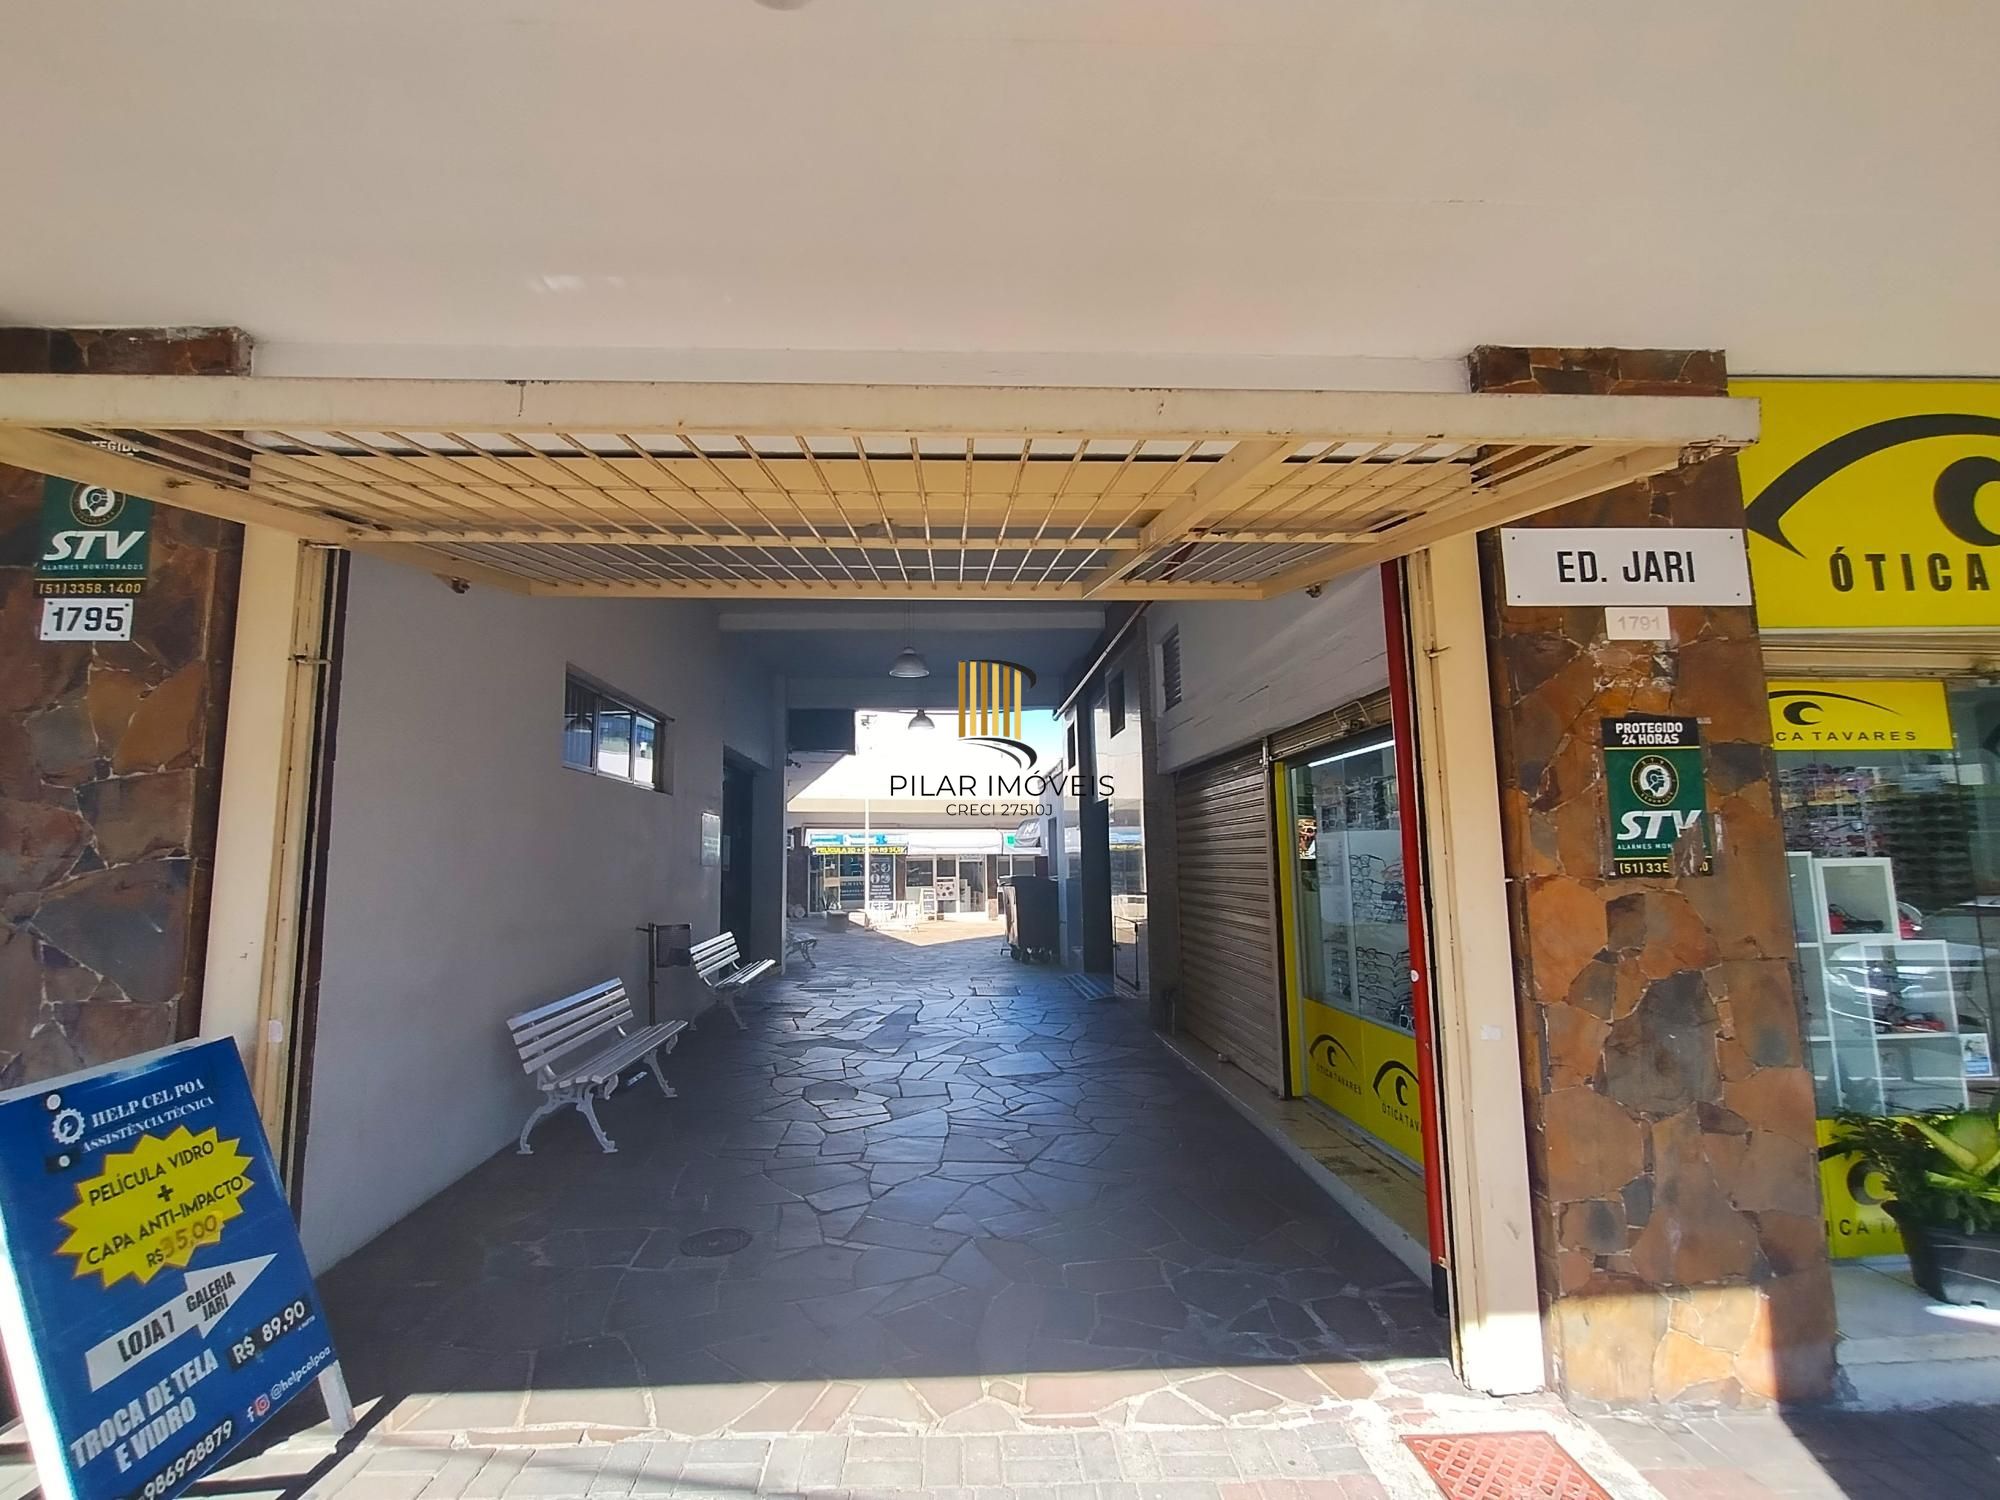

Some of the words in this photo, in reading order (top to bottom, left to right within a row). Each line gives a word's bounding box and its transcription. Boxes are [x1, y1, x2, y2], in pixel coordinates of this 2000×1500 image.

[43, 530, 146, 561] STV
[1557, 551, 1608, 583] ED.
[1622, 551, 1696, 583] JARI
[1829, 546, 1991, 592] ÓTICA
[52, 606, 124, 632] 1795
[1617, 616, 1661, 631] 1791
[1615, 722, 1683, 734] PROTEGIDO
[1621, 734, 1636, 745] 24
[1638, 734, 1680, 745] HORAS
[1812, 731, 1918, 741] TAVARES
[1616, 809, 1702, 841] STV
[91, 1100, 140, 1128] HELP
[142, 1093, 174, 1109] CEL
[175, 1078, 205, 1098] POA
[89, 1163, 166, 1206] PELÍCULA
[168, 1141, 214, 1169] VIDRO
[86, 1232, 135, 1264] CAPA
[139, 1176, 243, 1240] ANTI-IMPACTO
[186, 1271, 236, 1313] GALERIA
[203, 1292, 229, 1322] JARI
[117, 1319, 166, 1362] LOJA
[162, 1311, 176, 1333] 7
[232, 1336, 255, 1364] R$
[262, 1301, 305, 1342] 89,90
[70, 1398, 146, 1469] TROCA
[145, 1378, 175, 1416] DE
[170, 1347, 219, 1394] TELA
[114, 1442, 133, 1474] E
[129, 1396, 197, 1460] VIDRO
